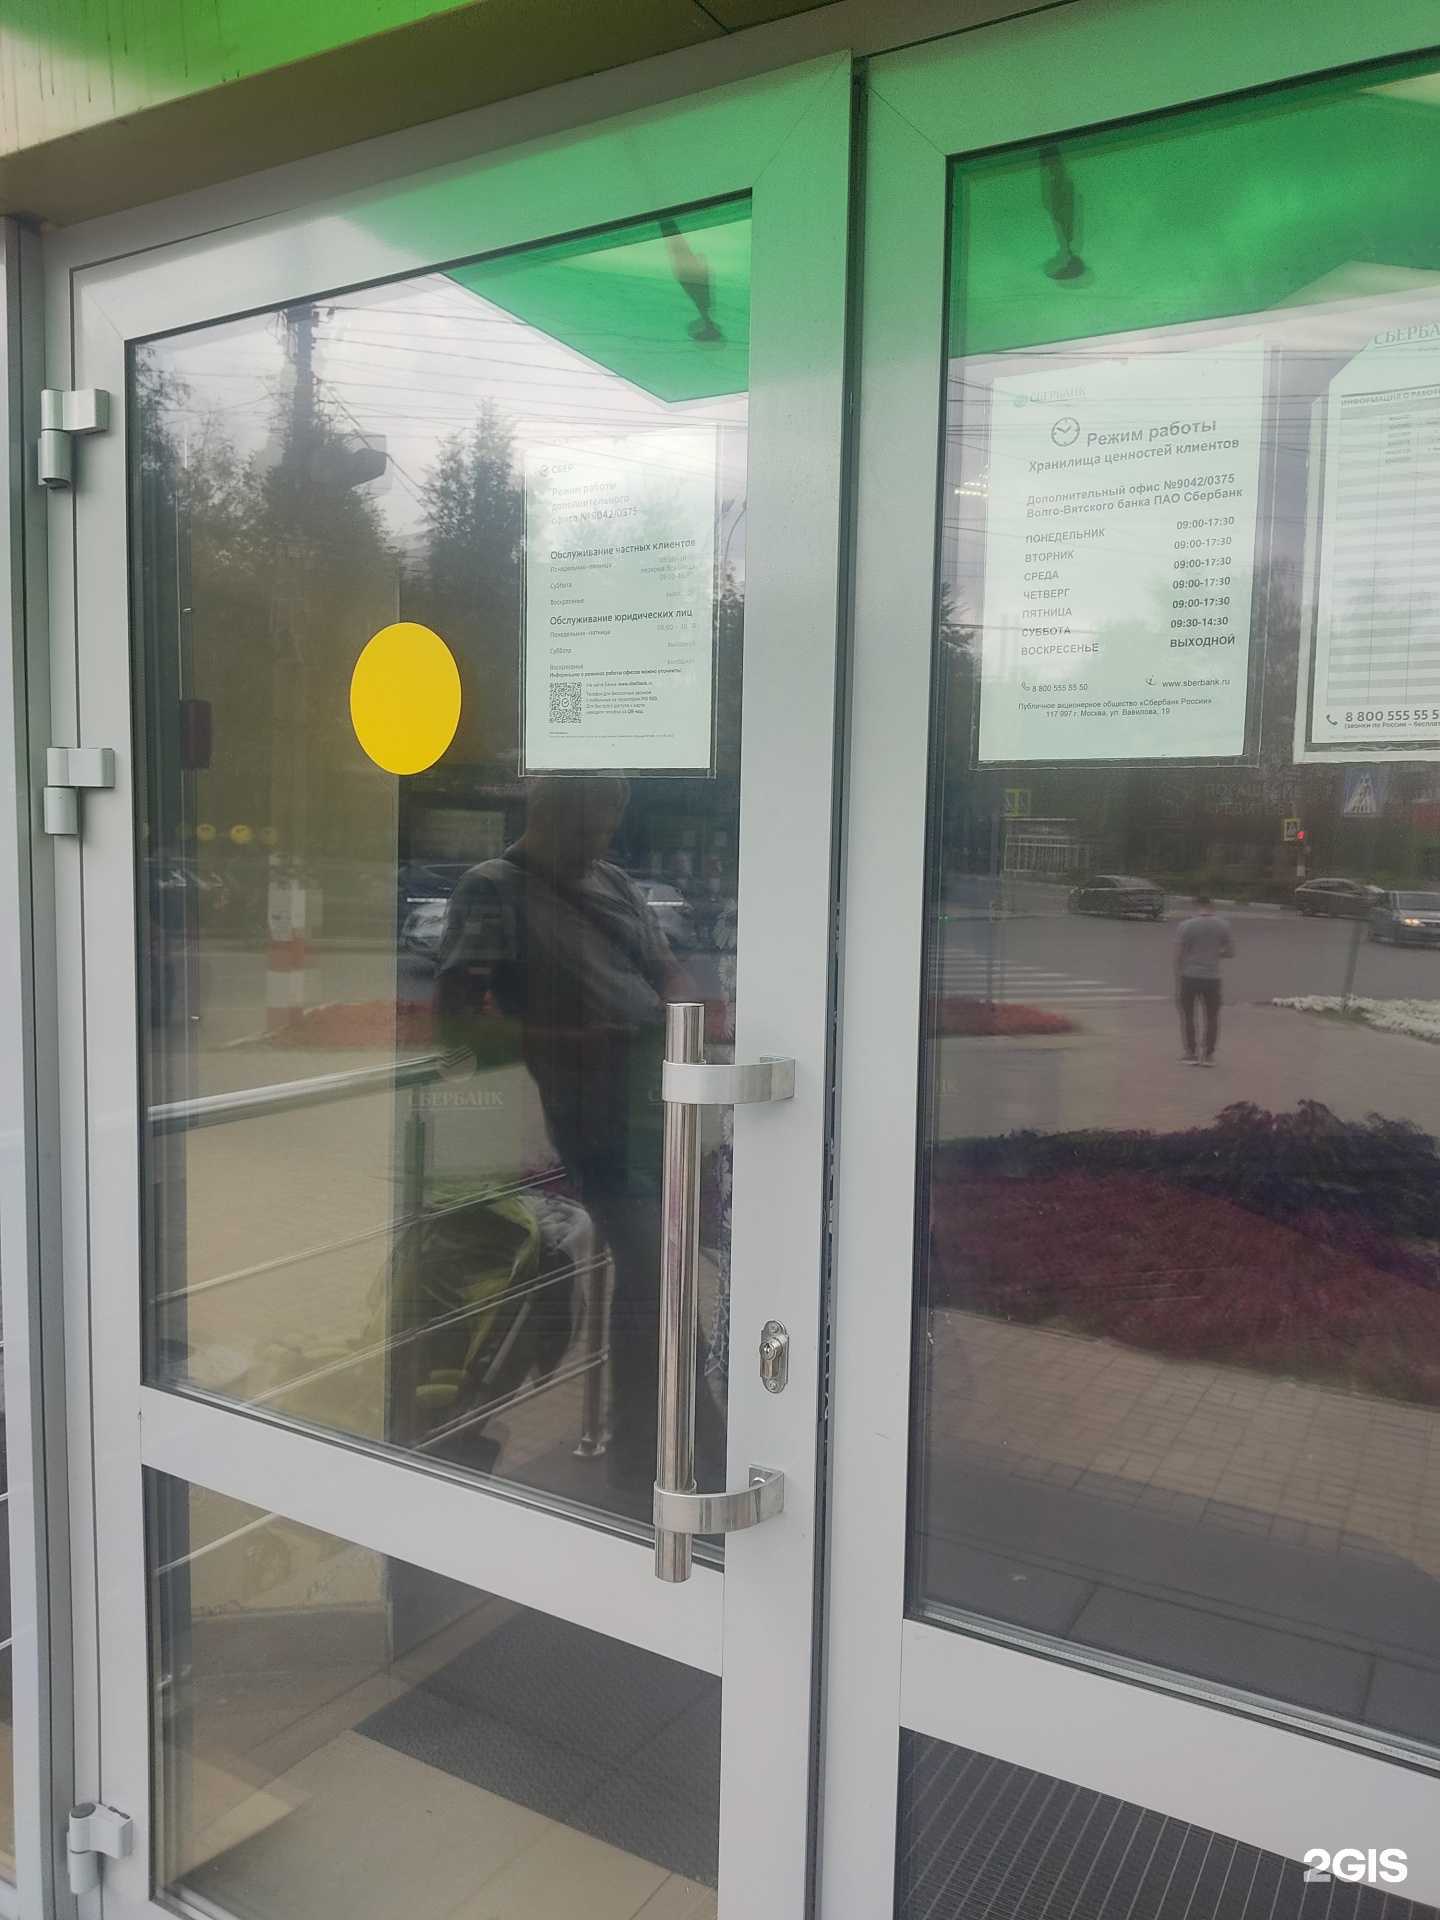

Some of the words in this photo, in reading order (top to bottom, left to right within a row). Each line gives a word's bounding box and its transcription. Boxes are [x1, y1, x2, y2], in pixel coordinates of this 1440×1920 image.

[1087, 429, 1143, 447] Режим
[1149, 419, 1217, 440] работы
[1028, 453, 1102, 473] Хранилища
[1104, 443, 1172, 463] ценностей
[1175, 437, 1240, 453] клиентов
[1027, 485, 1126, 507] Дополнительный
[1129, 480, 1160, 496] офис
[1163, 473, 1235, 490] №9042/0375
[1026, 500, 1115, 518] Волго-Вятского
[1117, 496, 1151, 509] банка
[1154, 491, 1181, 505] ПАО
[1184, 487, 1242, 505] Сбербанк
[1025, 527, 1105, 544] ПОНЕДЕЛЬНИК
[1176, 516, 1235, 530] 09:00-17:30
[550, 546, 614, 561] Обслуживание
[615, 542, 651, 556] частных
[652, 538, 696, 552] клиентов
[1024, 550, 1074, 563] ВТОРНИК
[1174, 535, 1232, 550] 09:00-17:30
[1024, 570, 1060, 582] СРЕДА
[1173, 556, 1232, 570] 09:00-17:30
[1023, 588, 1071, 601] ЧЕТВЕРГ
[1172, 576, 1231, 590] 09:00-17:30
[550, 615, 613, 627] Обслуживание
[614, 611, 674, 623] юридических
[675, 609, 693, 619] лиц
[1022, 607, 1073, 619] ПЯТНИЦА
[1172, 596, 1230, 609] 09:00-17:30
[1021, 625, 1071, 638] СУББОТА
[1170, 616, 1229, 629] 09:30-14:30
[1021, 643, 1100, 657] ВОСКРЕСЕНЬЕ
[1170, 635, 1235, 648] ВЫХОДНОЙ
[1031, 684, 1037, 693] 8
[1038, 684, 1052, 693] 800
[1053, 683, 1067, 692] 555
[1079, 682, 1089, 691] 50
[1161, 678, 1231, 689] www.sberbank.ru
[1045, 709, 1059, 718] 117
[1161, 707, 1171, 716] 19
[1102, 699, 1138, 709] общество
[1345, 711, 1354, 722] 8
[1356, 711, 1384, 722] 800
[1386, 710, 1411, 721] 555
[1413, 709, 1429, 720] 55
